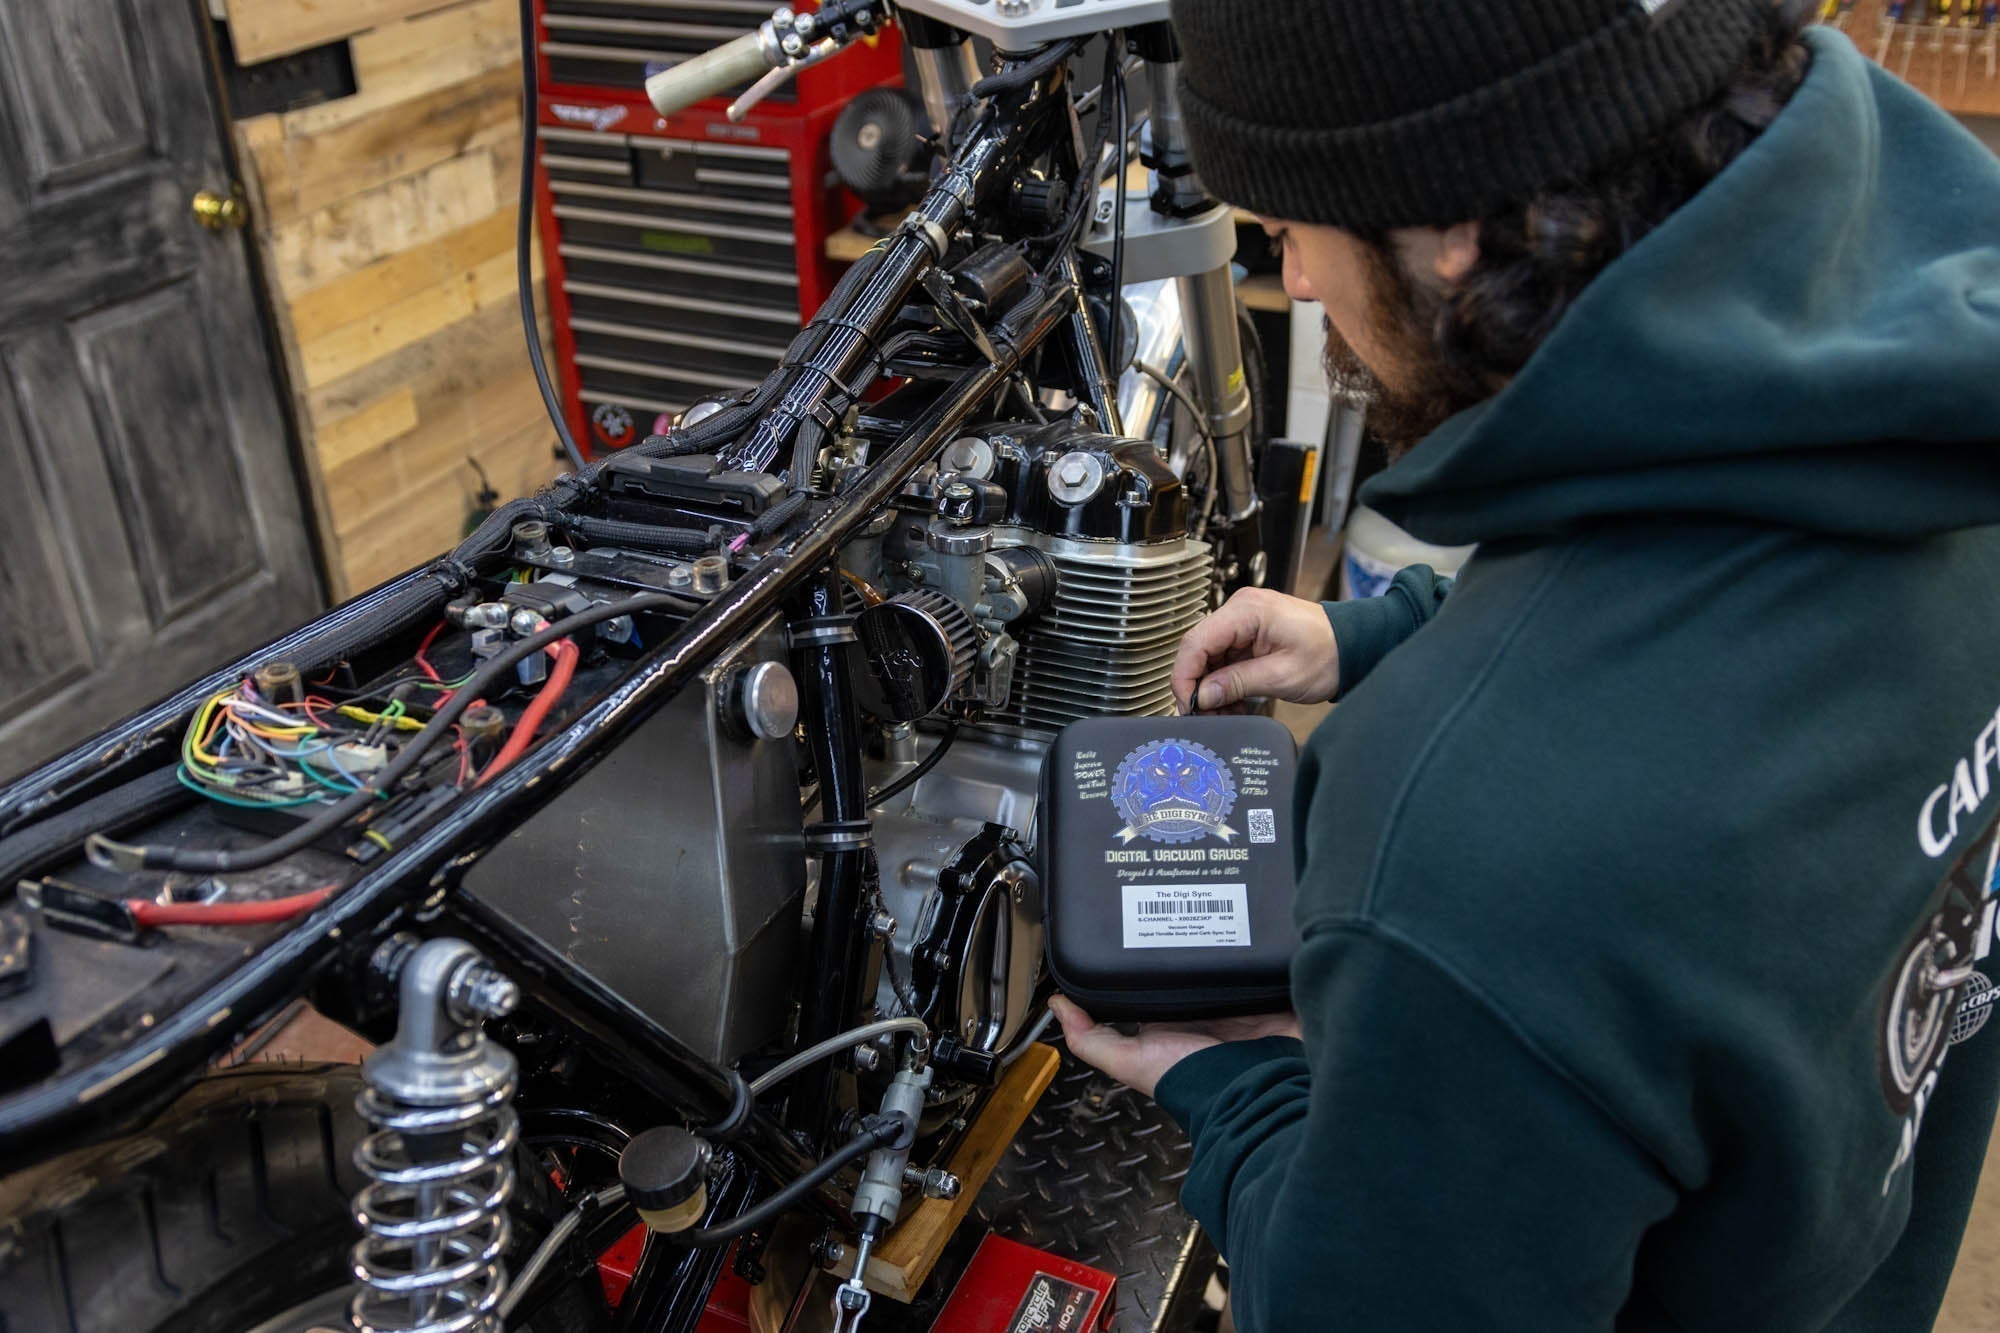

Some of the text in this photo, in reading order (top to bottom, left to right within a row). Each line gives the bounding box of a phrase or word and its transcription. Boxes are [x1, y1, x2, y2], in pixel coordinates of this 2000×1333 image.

[1241, 767, 1270, 775] Throttle
[1243, 777, 1267, 785] Bodies
[1918, 704, 2000, 858] CAF
[1160, 810, 1182, 819] DIGI
[1105, 848, 1249, 863] DIGITAL VACUUM GAUGE
[1174, 891, 1190, 899] Digi
[1192, 890, 1212, 898] Sync
[1030, 1293, 1056, 1328] LIFT
[1058, 1304, 1076, 1331] 1100
